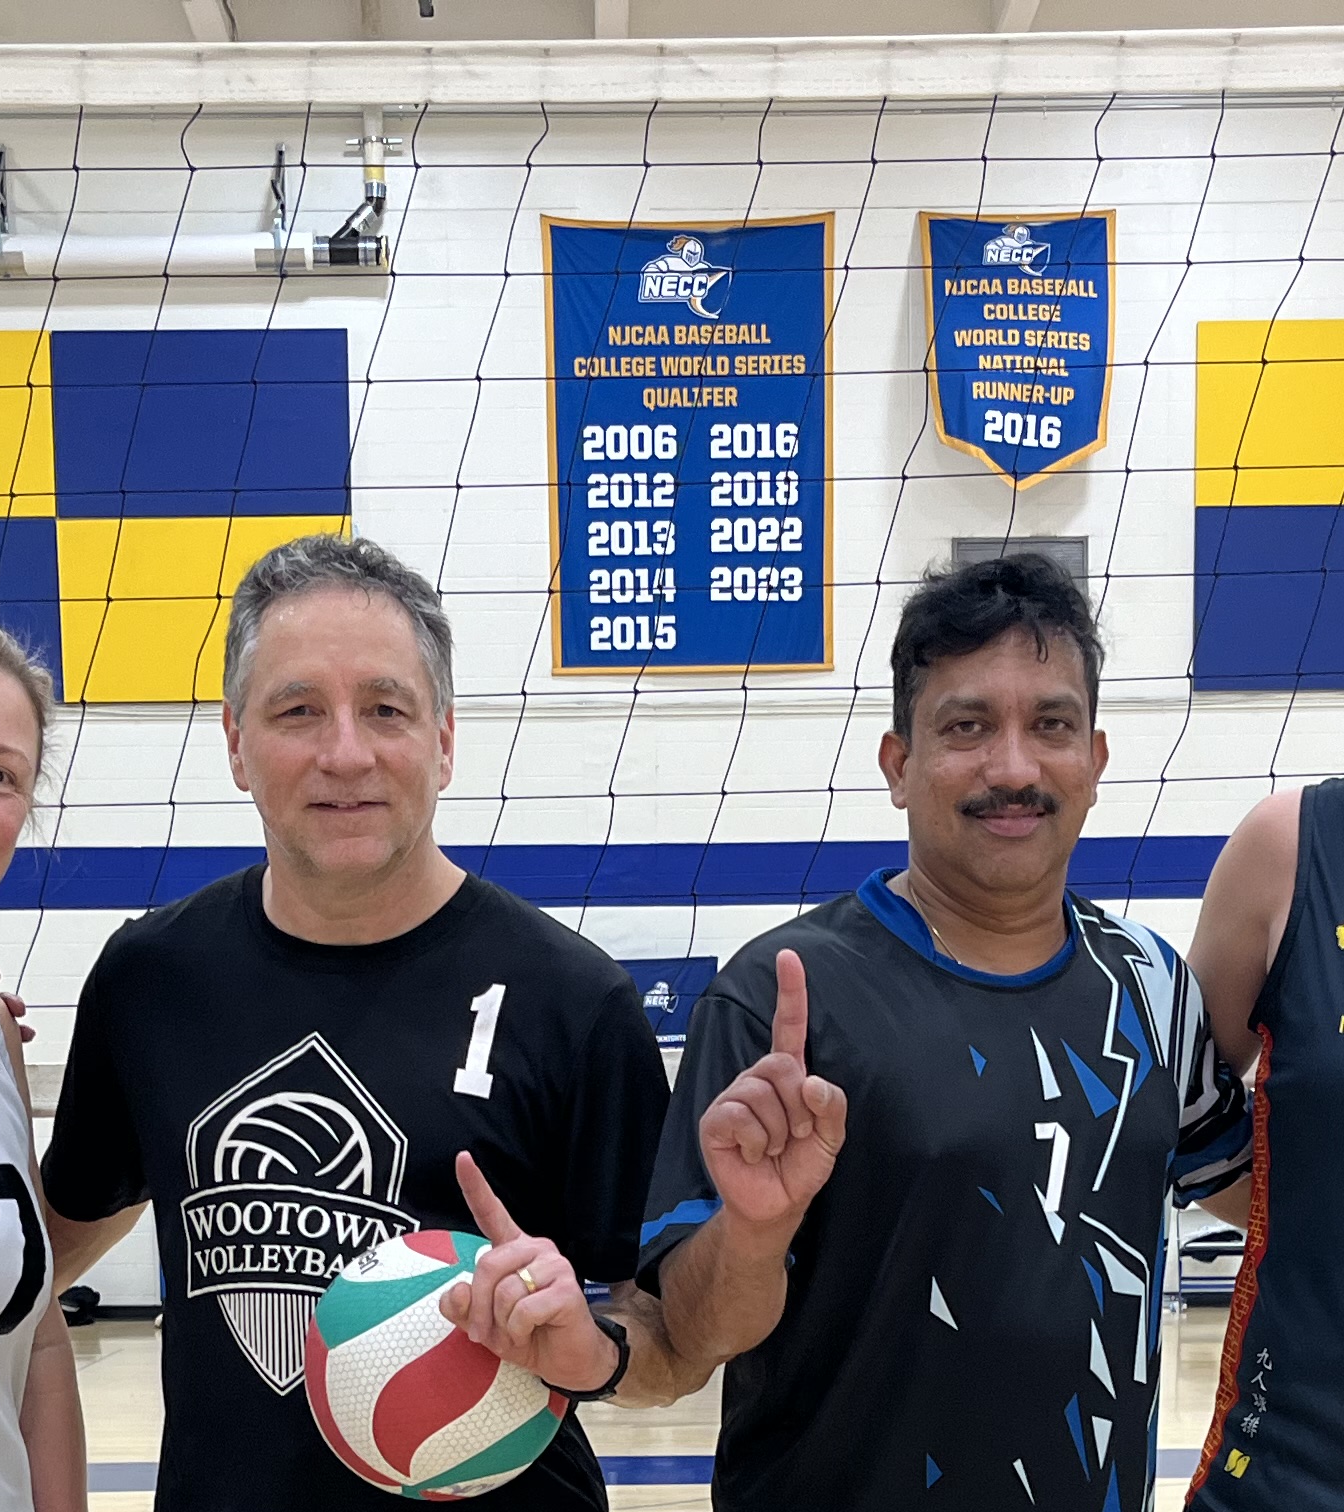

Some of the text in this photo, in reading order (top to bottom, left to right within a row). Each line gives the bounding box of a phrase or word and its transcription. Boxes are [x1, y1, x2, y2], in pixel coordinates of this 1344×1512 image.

[987, 249, 1034, 263] NECC
[644, 276, 708, 298] NECC
[944, 278, 1098, 298] NJCAA BASEBALL
[983, 303, 1062, 322] COLLEGE
[608, 324, 771, 346] NJCAA BASEBALL
[953, 329, 1091, 352] WORLD SERIES
[573, 354, 806, 378] COLLEGE WORLD SERIES
[978, 355, 1069, 377] NATIONAL
[972, 381, 1075, 406] RUNNER-UP
[582, 424, 678, 461] 2006
[710, 423, 799, 459] 2016
[983, 409, 1062, 449] 2016
[587, 472, 675, 509] 2012
[710, 470, 799, 507] 2018
[587, 520, 676, 557] 2013
[710, 517, 803, 553] 2022
[589, 568, 677, 604] 2014
[710, 566, 803, 602] 2023
[589, 615, 677, 651] 2015
[645, 995, 669, 1005] NECC
[453, 983, 506, 1099] 1
[187, 1200, 407, 1251] WOOTOWN
[194, 1244, 346, 1279] VOLLEYBA
